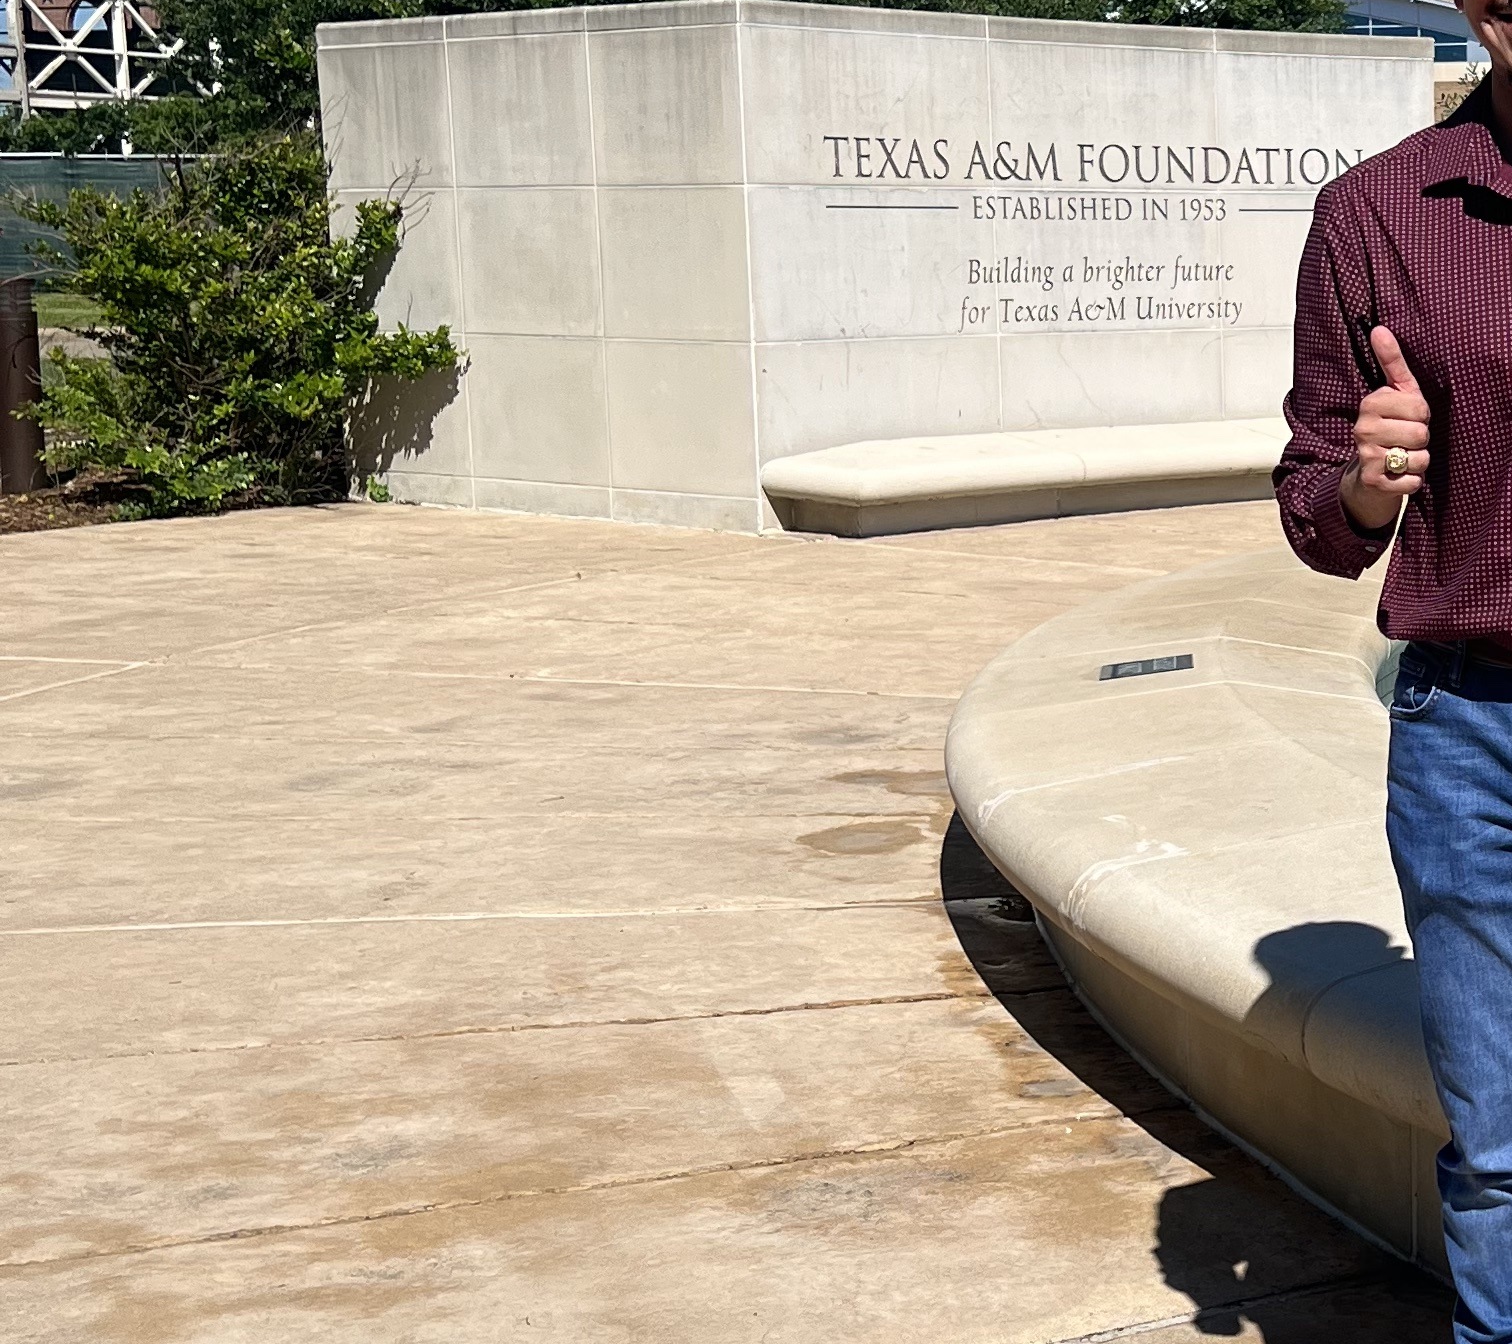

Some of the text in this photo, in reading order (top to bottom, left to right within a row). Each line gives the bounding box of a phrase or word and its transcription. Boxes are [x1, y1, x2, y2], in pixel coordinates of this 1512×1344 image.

[823, 135, 950, 180] TEXAS
[963, 140, 1062, 182] A&M
[972, 195, 1227, 221] ESTABLISHED IN 1953
[968, 255, 1235, 291] Building a brighter future
[958, 296, 1243, 333] for Texas A&M University
